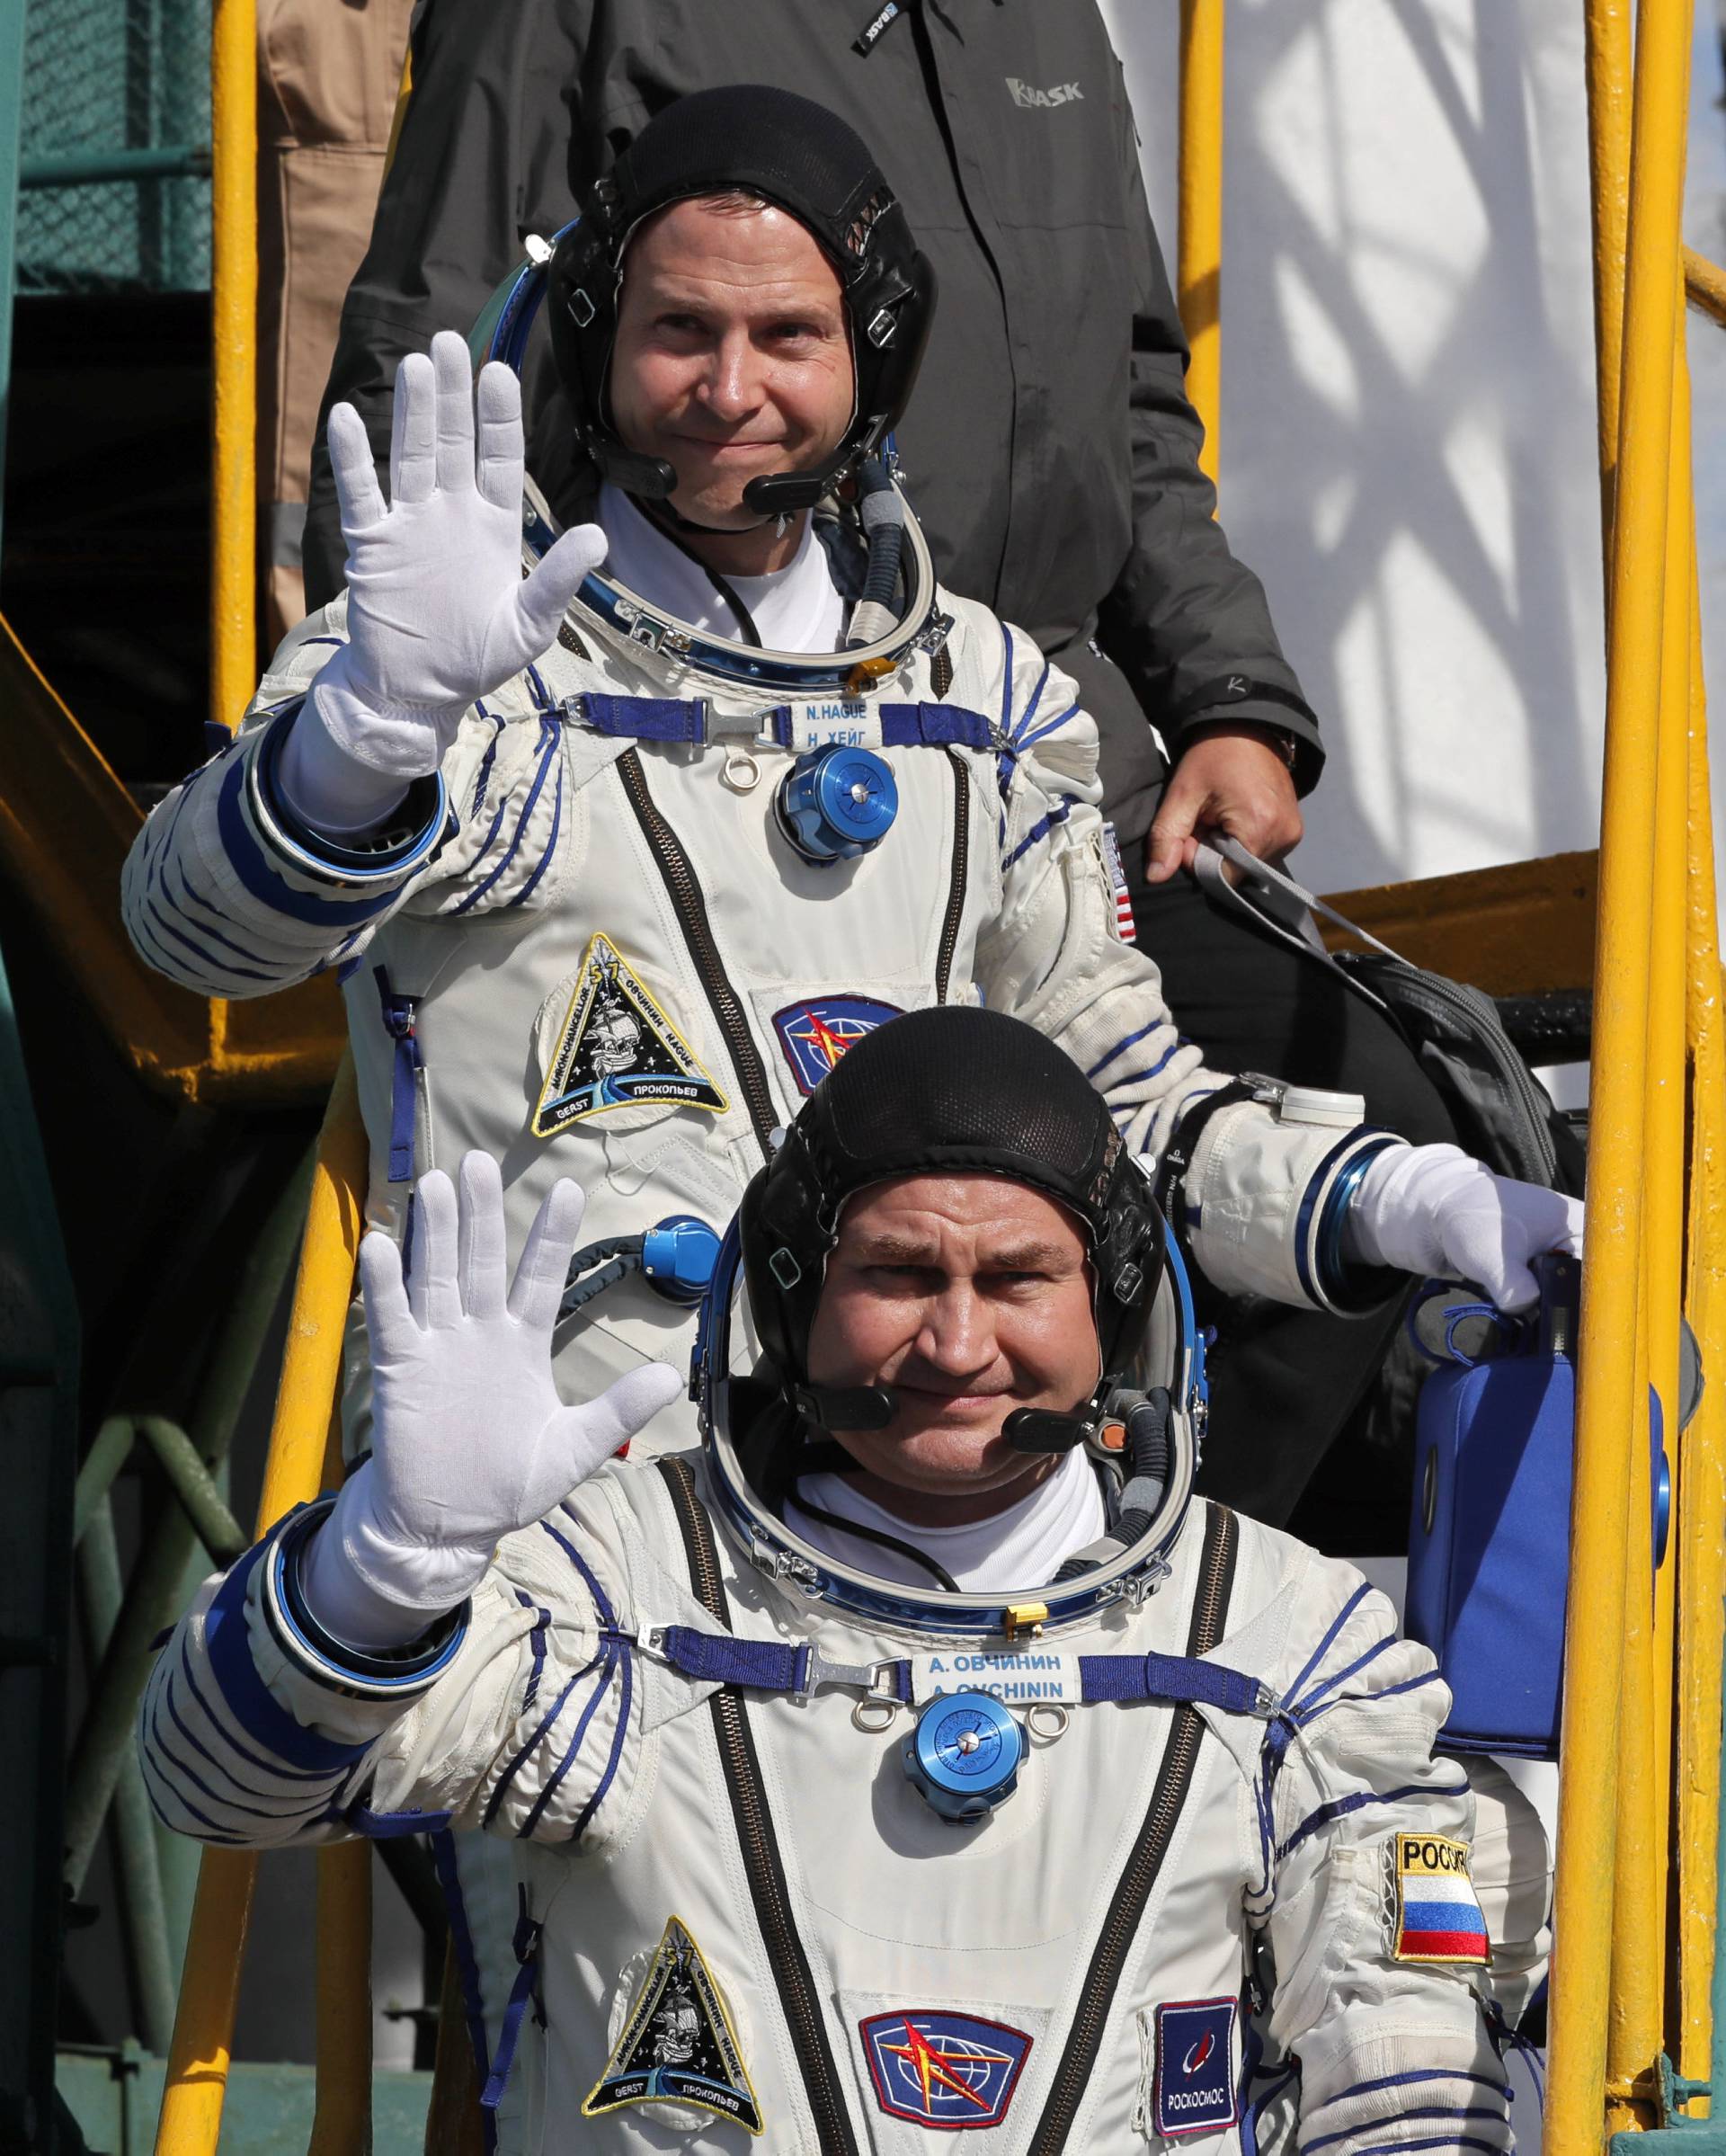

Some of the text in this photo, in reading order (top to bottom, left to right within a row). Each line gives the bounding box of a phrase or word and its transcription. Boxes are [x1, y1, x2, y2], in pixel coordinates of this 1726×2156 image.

[866, 11, 891, 42] BASK
[806, 704, 867, 720] N. HAGUE
[828, 727, 866, 747] ХЕЙГ
[626, 979, 663, 1028] ОВЧИНИН
[665, 1032, 694, 1068] HAGUE
[634, 1084, 698, 1097] ПРОКОПЬЕВ
[556, 1098, 589, 1119] GERST
[929, 1654, 1061, 1673] А. ОВЧИНИН
[721, 2036, 743, 2079] HAGUE
[615, 2082, 644, 2098] GERST
[682, 2084, 740, 2111] ПРОКОПЬЕВ
[1169, 2088, 1223, 2110] РОСКОСМОС
